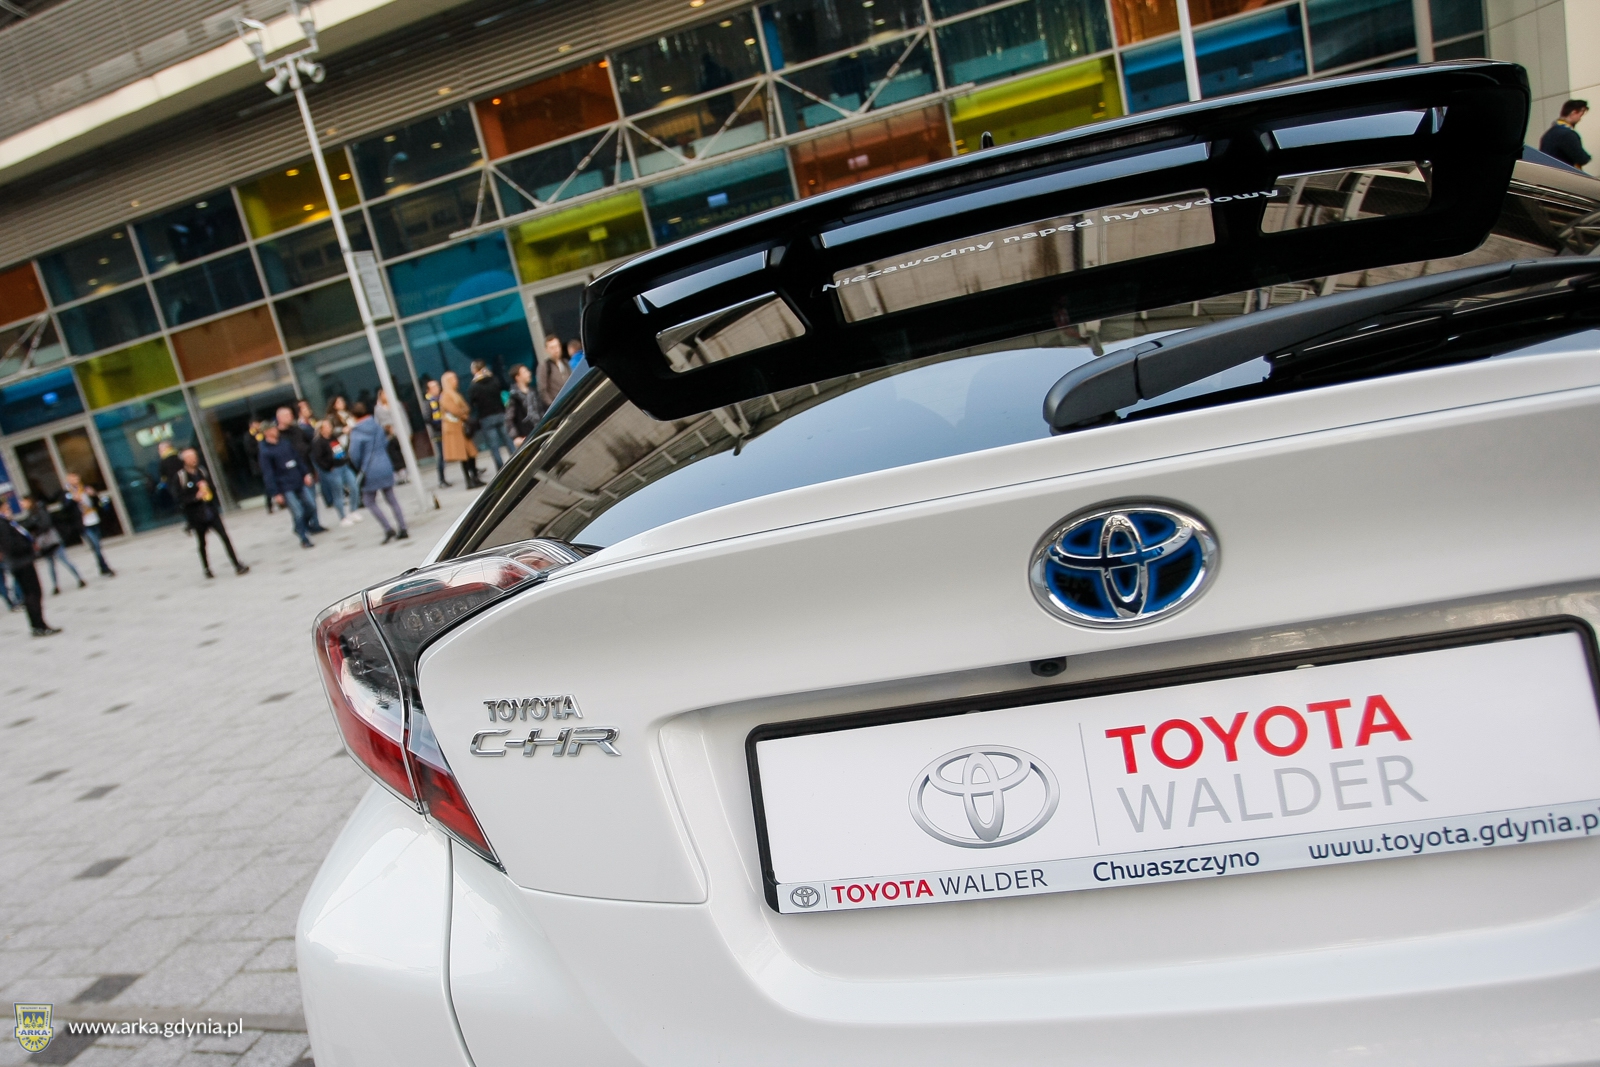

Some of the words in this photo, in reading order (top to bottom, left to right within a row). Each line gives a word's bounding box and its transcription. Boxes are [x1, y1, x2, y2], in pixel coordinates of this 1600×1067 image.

[823, 240, 994, 292] Niezawodny
[1002, 219, 1093, 245] napęd
[1102, 190, 1279, 223] hybrydowy
[470, 726, 622, 757] C-HR
[484, 694, 583, 722] TOYOTA
[1105, 694, 1412, 775] TOYOTA
[1117, 754, 1428, 833] WALDER
[831, 880, 934, 904] TOYOTA
[938, 868, 1048, 895] WALDER
[1093, 850, 1260, 882] Chwaszczyno
[1308, 808, 1600, 860] www.toyota.gdynia.p
